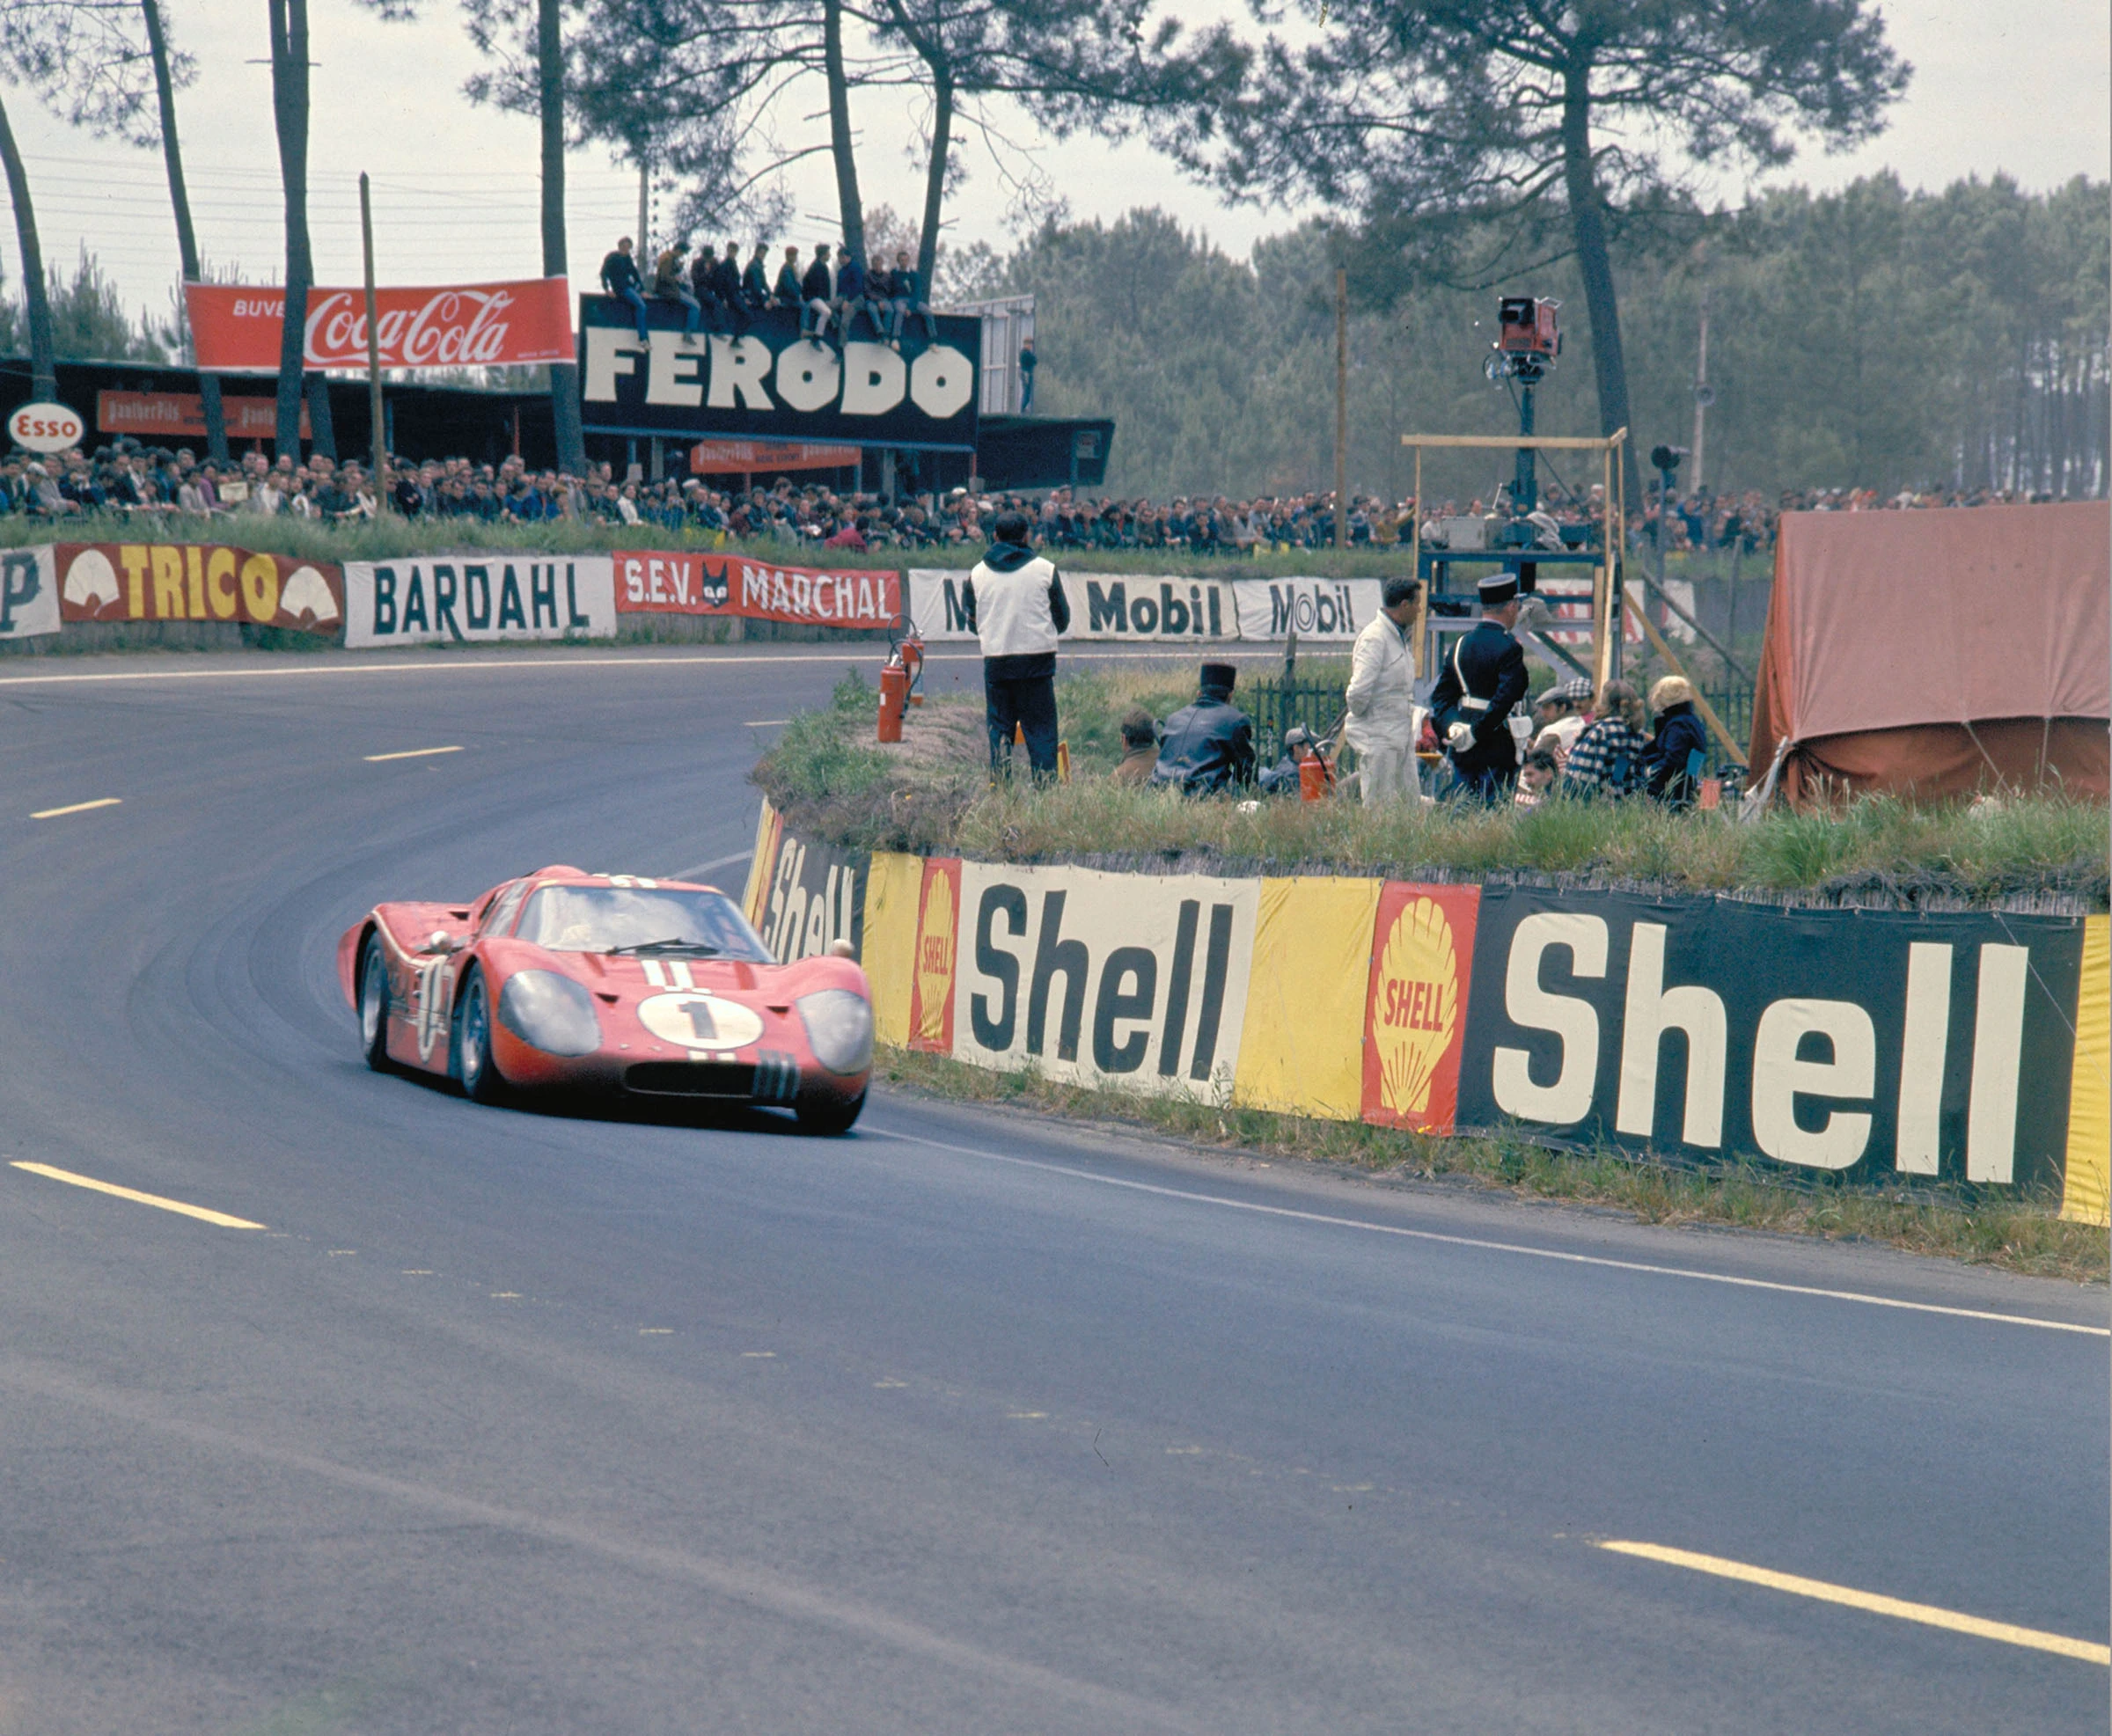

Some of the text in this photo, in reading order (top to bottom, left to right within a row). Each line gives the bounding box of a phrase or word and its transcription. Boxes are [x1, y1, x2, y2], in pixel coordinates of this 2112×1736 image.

[232, 299, 286, 317] BUVE
[303, 289, 515, 363] Coca-Cola
[583, 326, 973, 419] FERODO
[17, 414, 77, 438] Esso
[121, 545, 279, 619] TRICO
[373, 563, 590, 641] BARDAHL
[624, 559, 697, 606] S.E.V.
[742, 565, 894, 620] MARCHAL
[1086, 580, 1222, 636] Mobil
[1269, 583, 1355, 634] Mobil
[764, 838, 854, 966] Shell
[923, 936, 949, 975] SHELL
[970, 883, 1234, 1082] Shell
[678, 1000, 718, 1040] 1
[1384, 978, 1445, 1033] SHELL
[1492, 912, 2029, 1184] Shell
